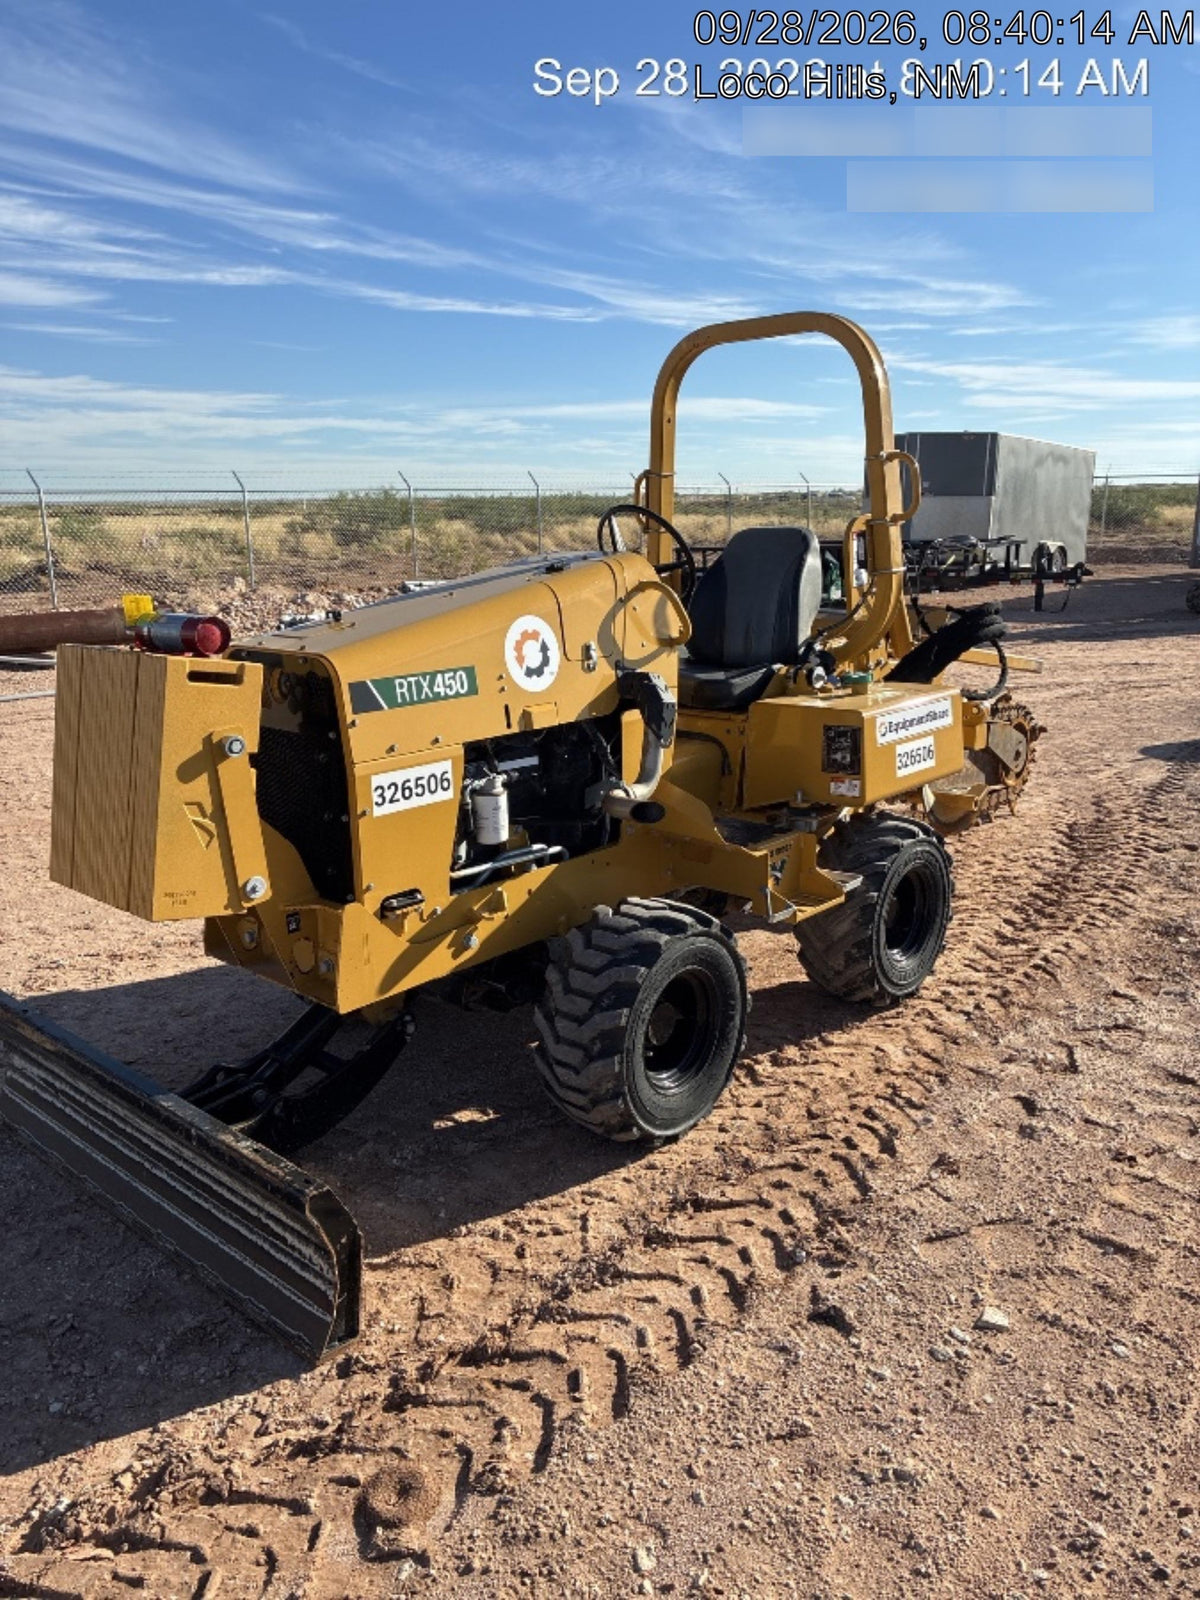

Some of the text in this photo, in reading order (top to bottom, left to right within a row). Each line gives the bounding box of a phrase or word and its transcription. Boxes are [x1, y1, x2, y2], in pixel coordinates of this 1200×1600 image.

[394, 669, 468, 703] RTX450
[897, 744, 934, 770] 326506
[374, 771, 451, 807] 326506
